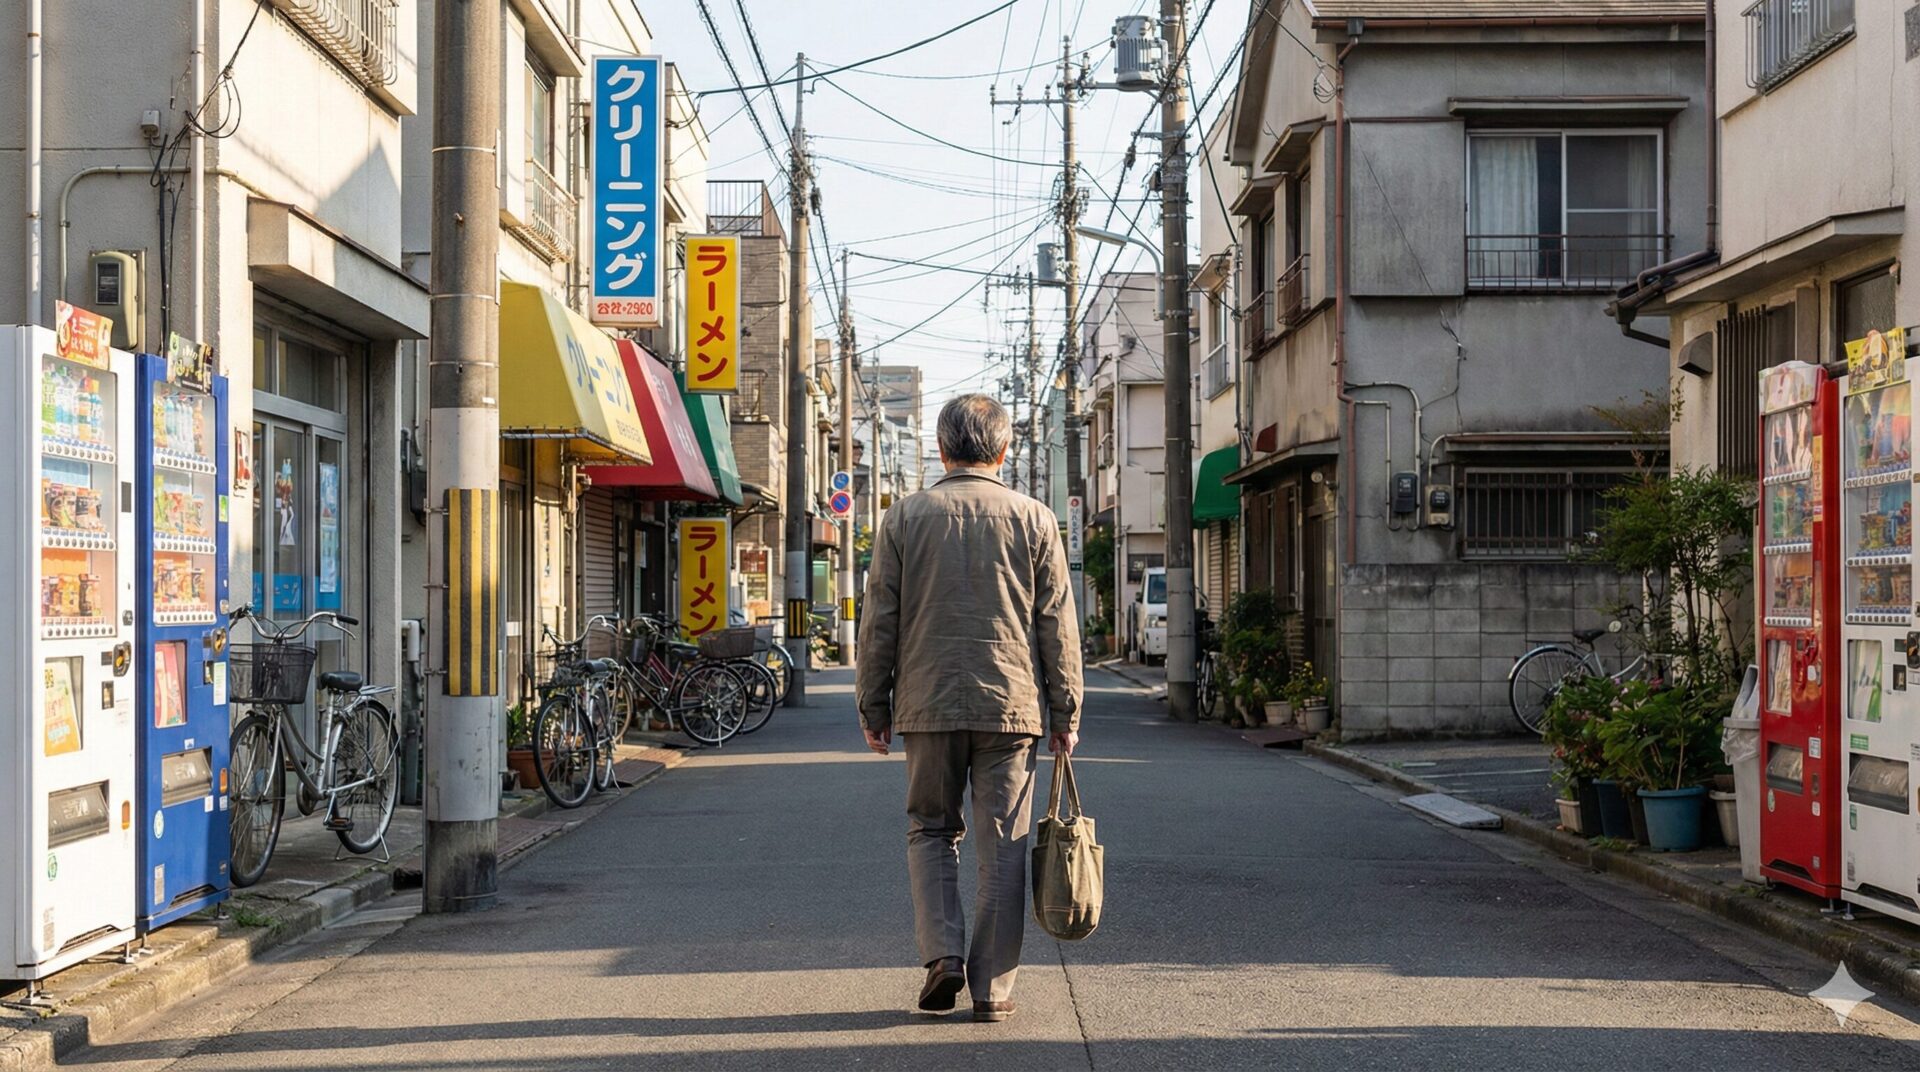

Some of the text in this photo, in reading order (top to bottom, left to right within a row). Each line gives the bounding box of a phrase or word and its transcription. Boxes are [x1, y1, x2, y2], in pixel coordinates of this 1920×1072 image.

[605, 64, 648, 290] クリーニング
[696, 245, 728, 382] ラーメン
[688, 526, 718, 637] ラーメン
